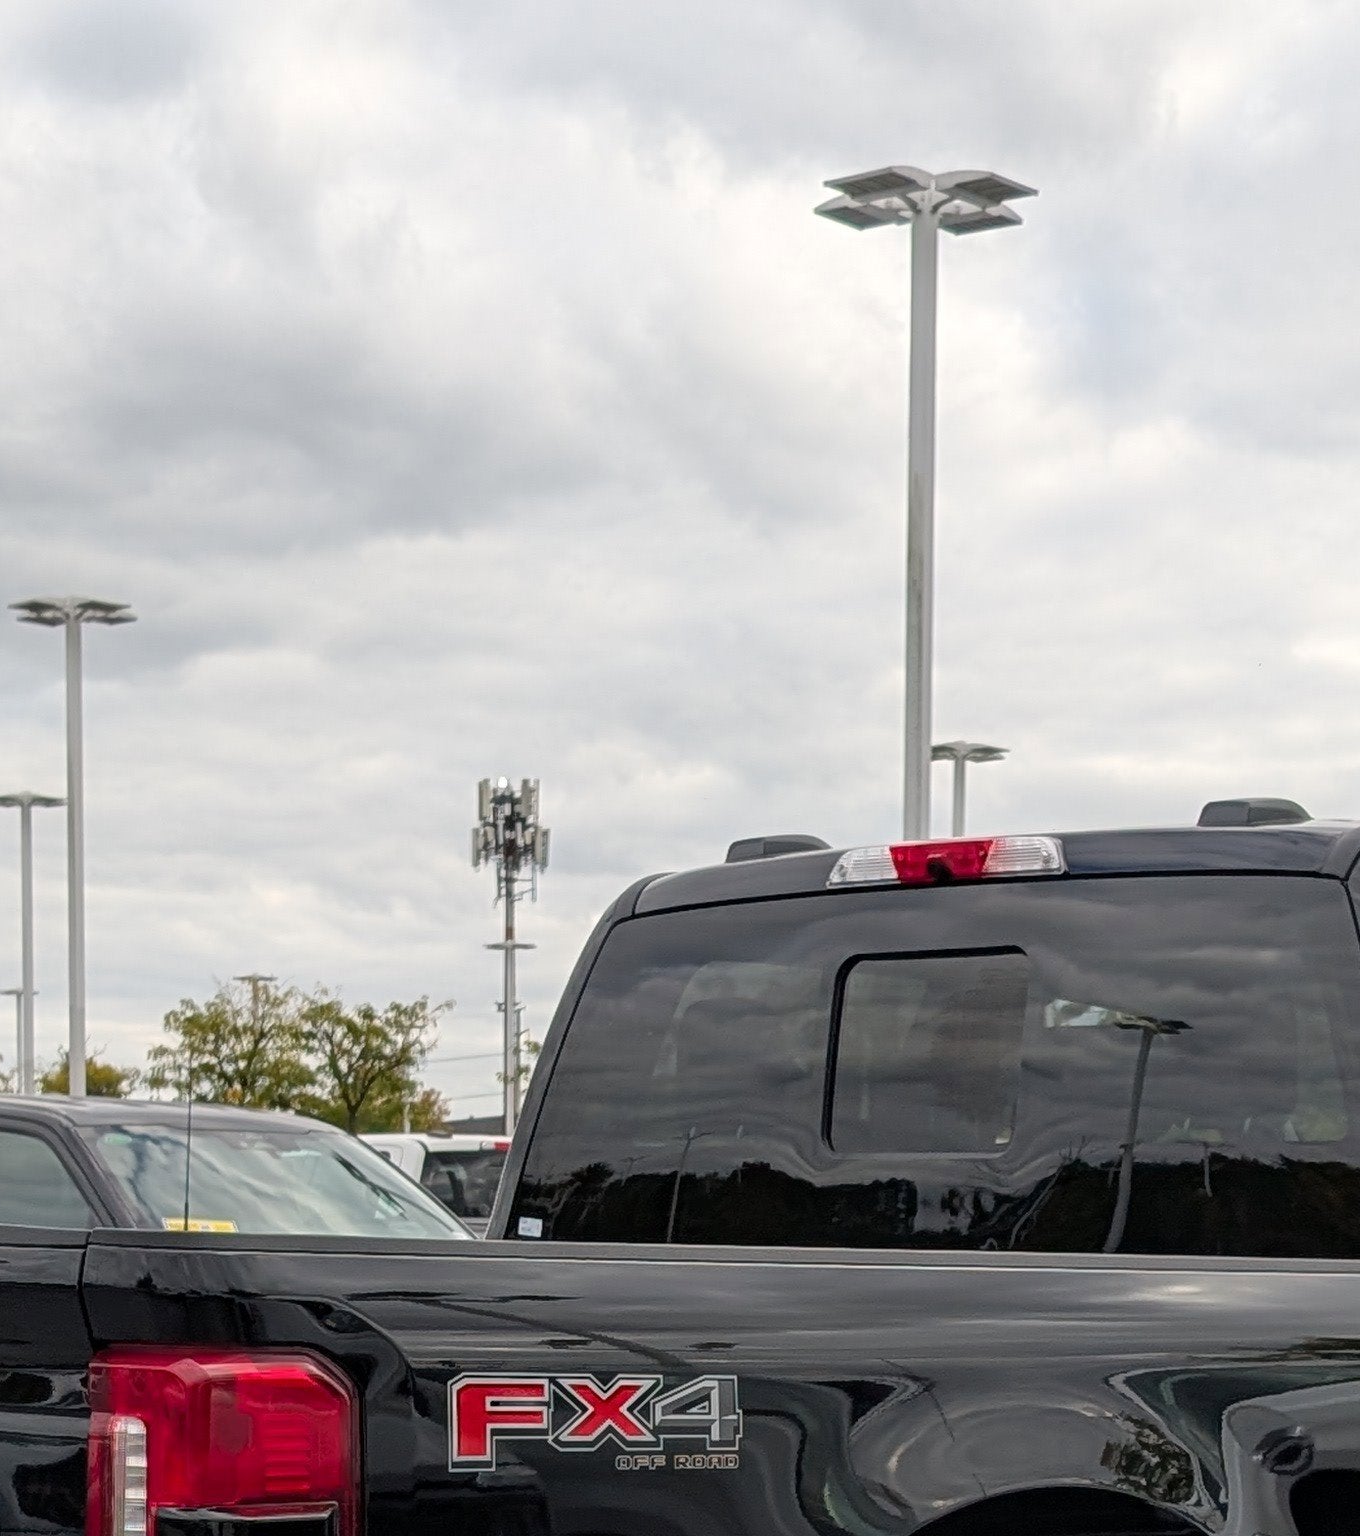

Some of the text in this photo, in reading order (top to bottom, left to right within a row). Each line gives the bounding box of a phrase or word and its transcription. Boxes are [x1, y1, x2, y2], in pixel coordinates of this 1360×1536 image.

[448, 1372, 742, 1472] FX4
[615, 1454, 739, 1470] OFF ROAD
